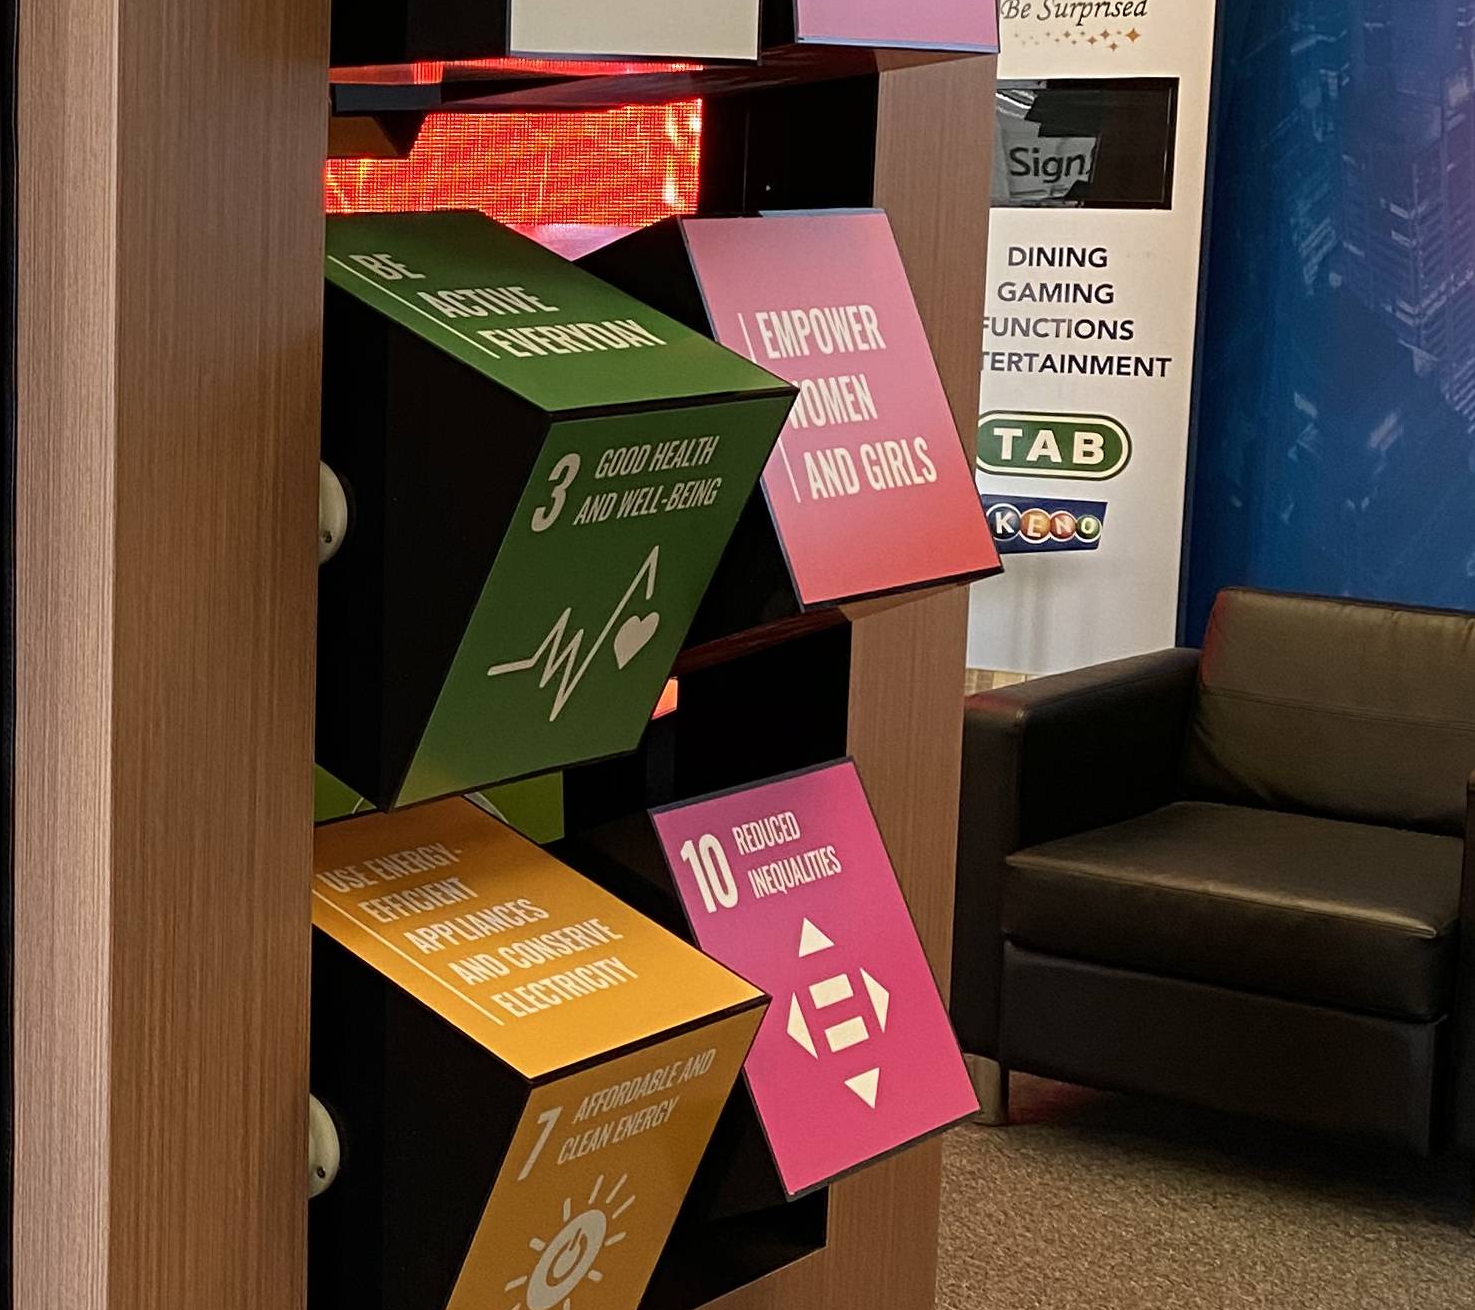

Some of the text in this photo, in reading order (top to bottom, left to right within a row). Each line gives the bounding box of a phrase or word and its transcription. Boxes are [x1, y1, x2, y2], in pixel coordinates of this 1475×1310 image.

[1009, 146, 1095, 184] Sign
[349, 253, 426, 281] BE
[1007, 246, 1109, 268] DINING
[416, 286, 560, 319] ACTIVE
[997, 281, 1115, 304] GAMING
[477, 319, 667, 358] EVERYDAY
[755, 304, 887, 360] EMPOWER
[594, 435, 720, 479] GOOD HEALTH
[803, 436, 938, 500] AND GIRLS
[993, 427, 1105, 465] TAB
[530, 452, 581, 533] 3
[572, 477, 723, 526] AND WELL-BEING
[994, 511, 1096, 539] KENO
[731, 811, 801, 855] REDUCED
[315, 841, 463, 894] USE ENERGY-
[680, 833, 739, 914] 10
[747, 845, 843, 899] INEQUALITIES
[357, 876, 479, 924] EFFICIENT
[403, 897, 551, 955] APPLIANCES
[447, 917, 624, 987] AND CONSERVE
[489, 956, 639, 1019] ELECTRICITY
[571, 1047, 717, 1125] AFFORDABLE AND
[517, 1105, 564, 1182] 7
[556, 1096, 680, 1166] CLEAN ENERGY
